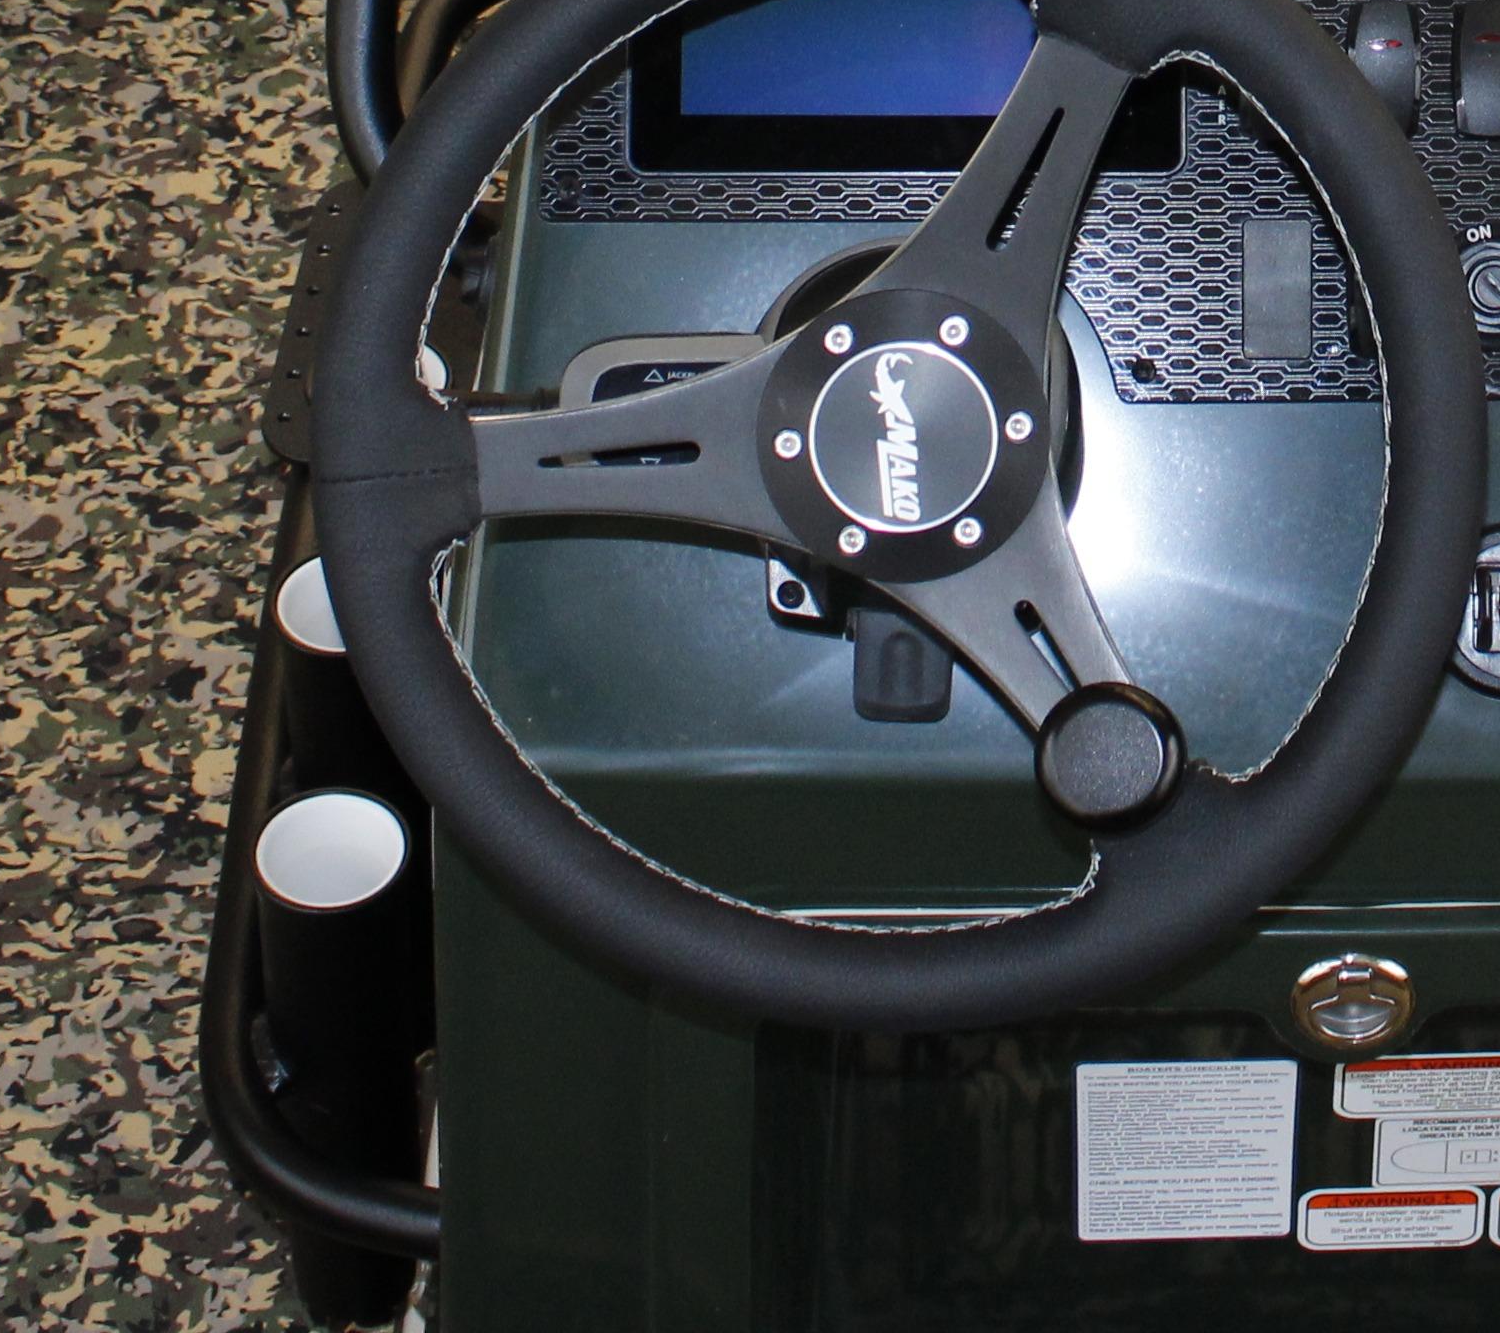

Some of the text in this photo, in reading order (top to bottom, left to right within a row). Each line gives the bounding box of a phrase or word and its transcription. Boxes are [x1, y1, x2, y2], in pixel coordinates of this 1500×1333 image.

[1466, 224, 1492, 242] ON
[876, 417, 921, 522] MAKO
[1349, 1196, 1436, 1205] WARNING
